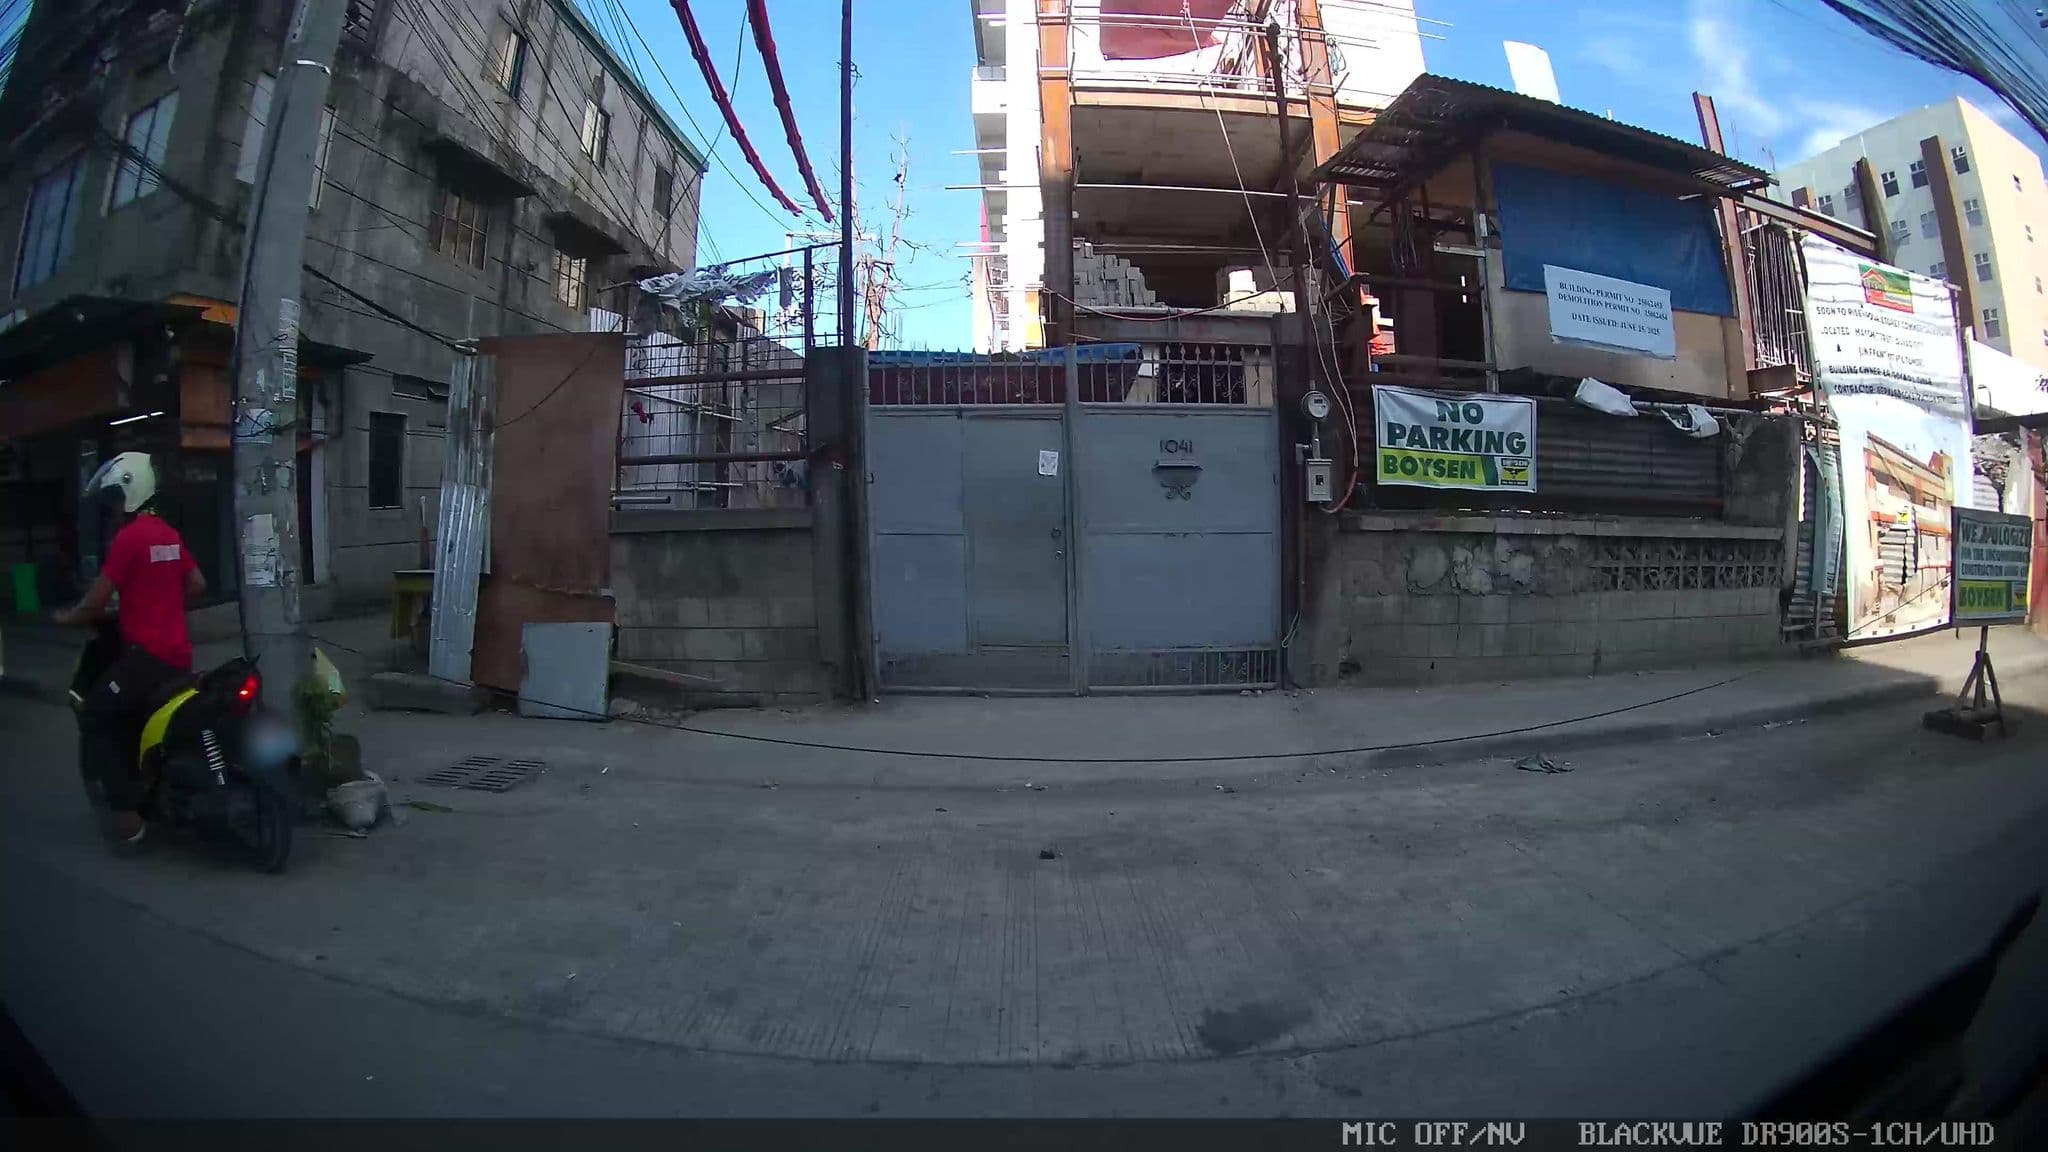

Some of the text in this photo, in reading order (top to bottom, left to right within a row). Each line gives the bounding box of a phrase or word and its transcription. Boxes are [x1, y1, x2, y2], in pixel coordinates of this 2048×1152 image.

[1560, 282, 1595, 296] BUILDING
[1596, 288, 1622, 301] PERMIT
[1558, 293, 1603, 307] DEMOLITION
[1605, 301, 1628, 312] PERMIT
[1837, 307, 1847, 317] TO
[1572, 312, 1591, 322] DATE
[1621, 321, 1637, 331] JUNE
[1436, 400, 1484, 425] NO
[1160, 439, 1193, 454] 1041
[1387, 422, 1527, 455] PARKING
[1383, 454, 1476, 480] BOYSEN
[1961, 521, 1977, 543] WE
